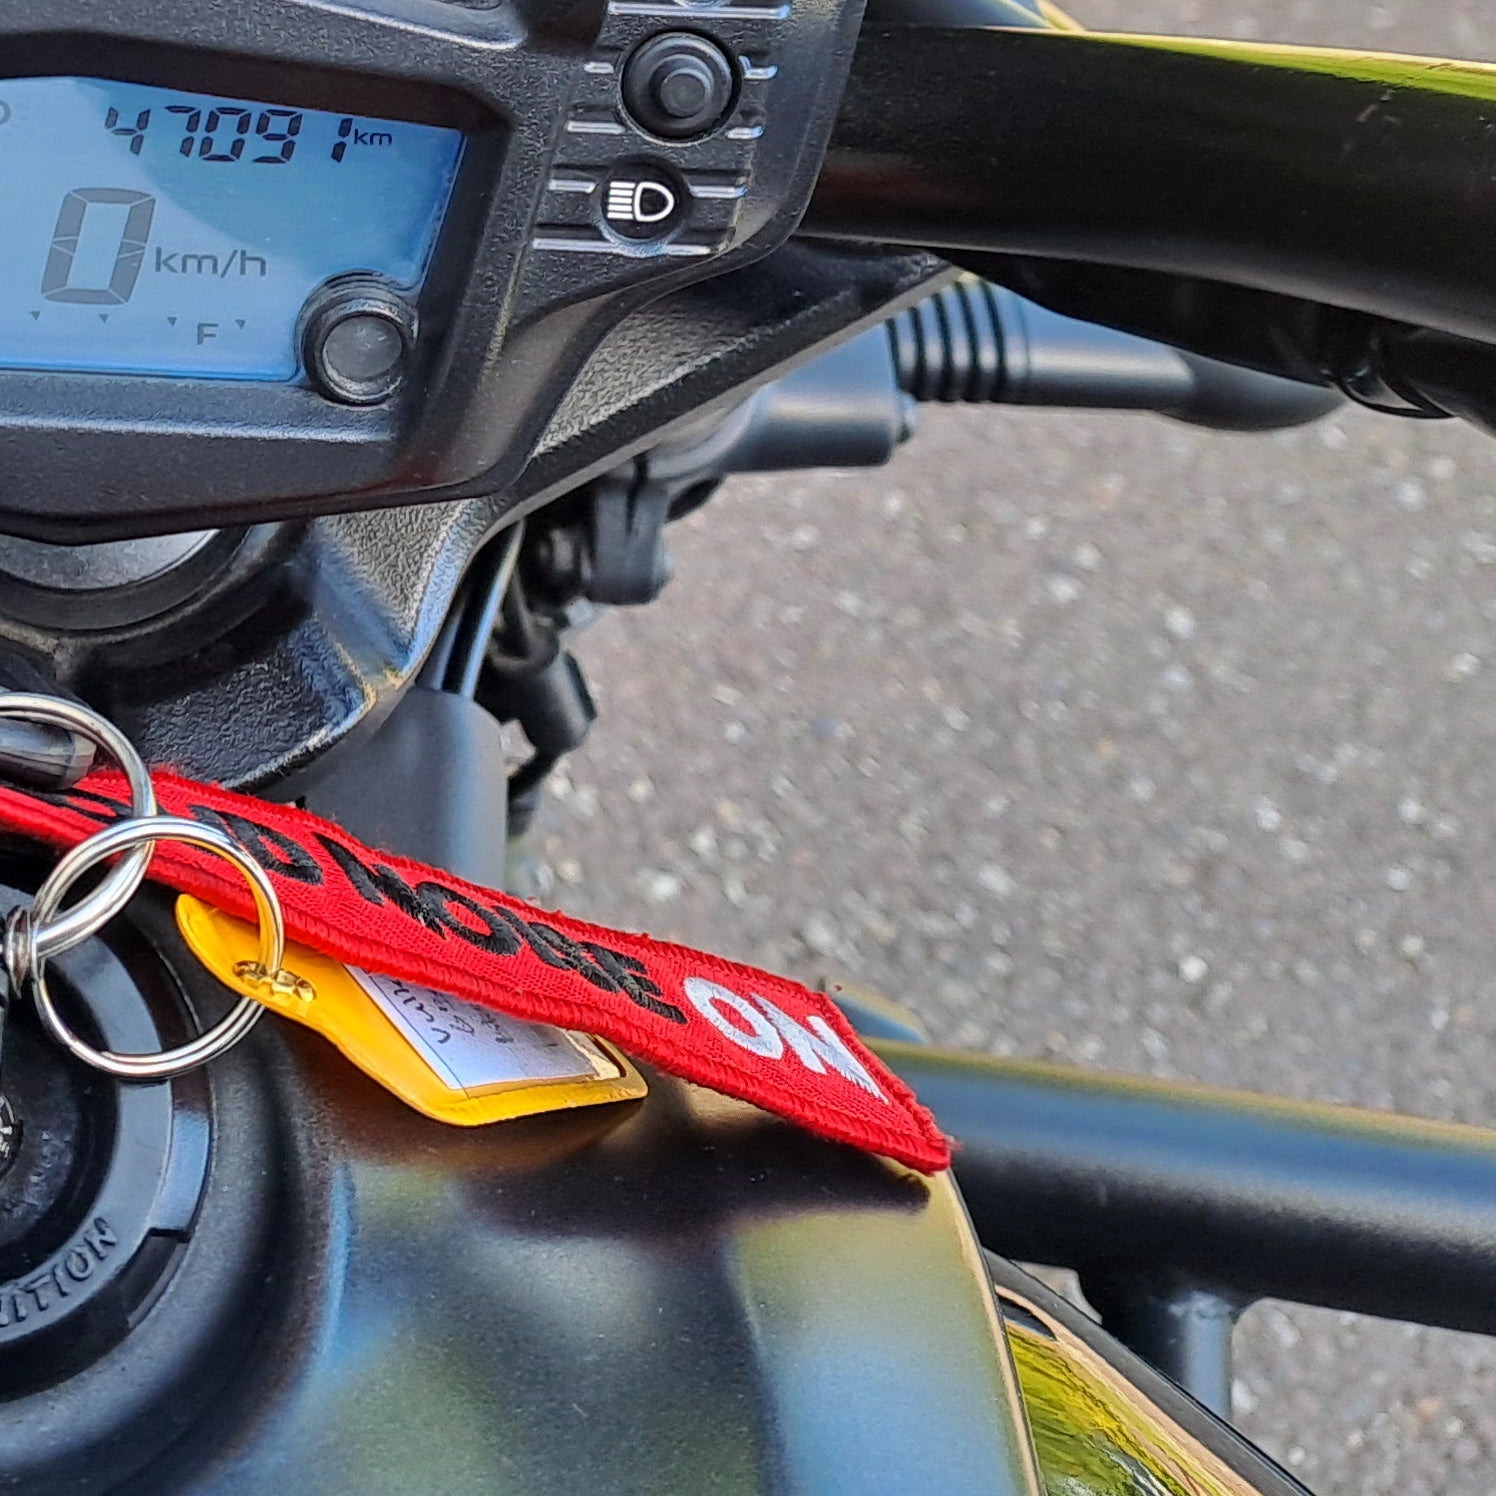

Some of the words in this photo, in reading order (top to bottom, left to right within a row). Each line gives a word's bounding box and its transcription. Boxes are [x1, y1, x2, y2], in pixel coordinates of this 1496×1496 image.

[105, 105, 353, 163] 47091
[354, 127, 393, 147] km
[41, 187, 156, 305] 0
[155, 246, 267, 279] km/h
[197, 323, 219, 345] F
[684, 977, 890, 1105] ON
